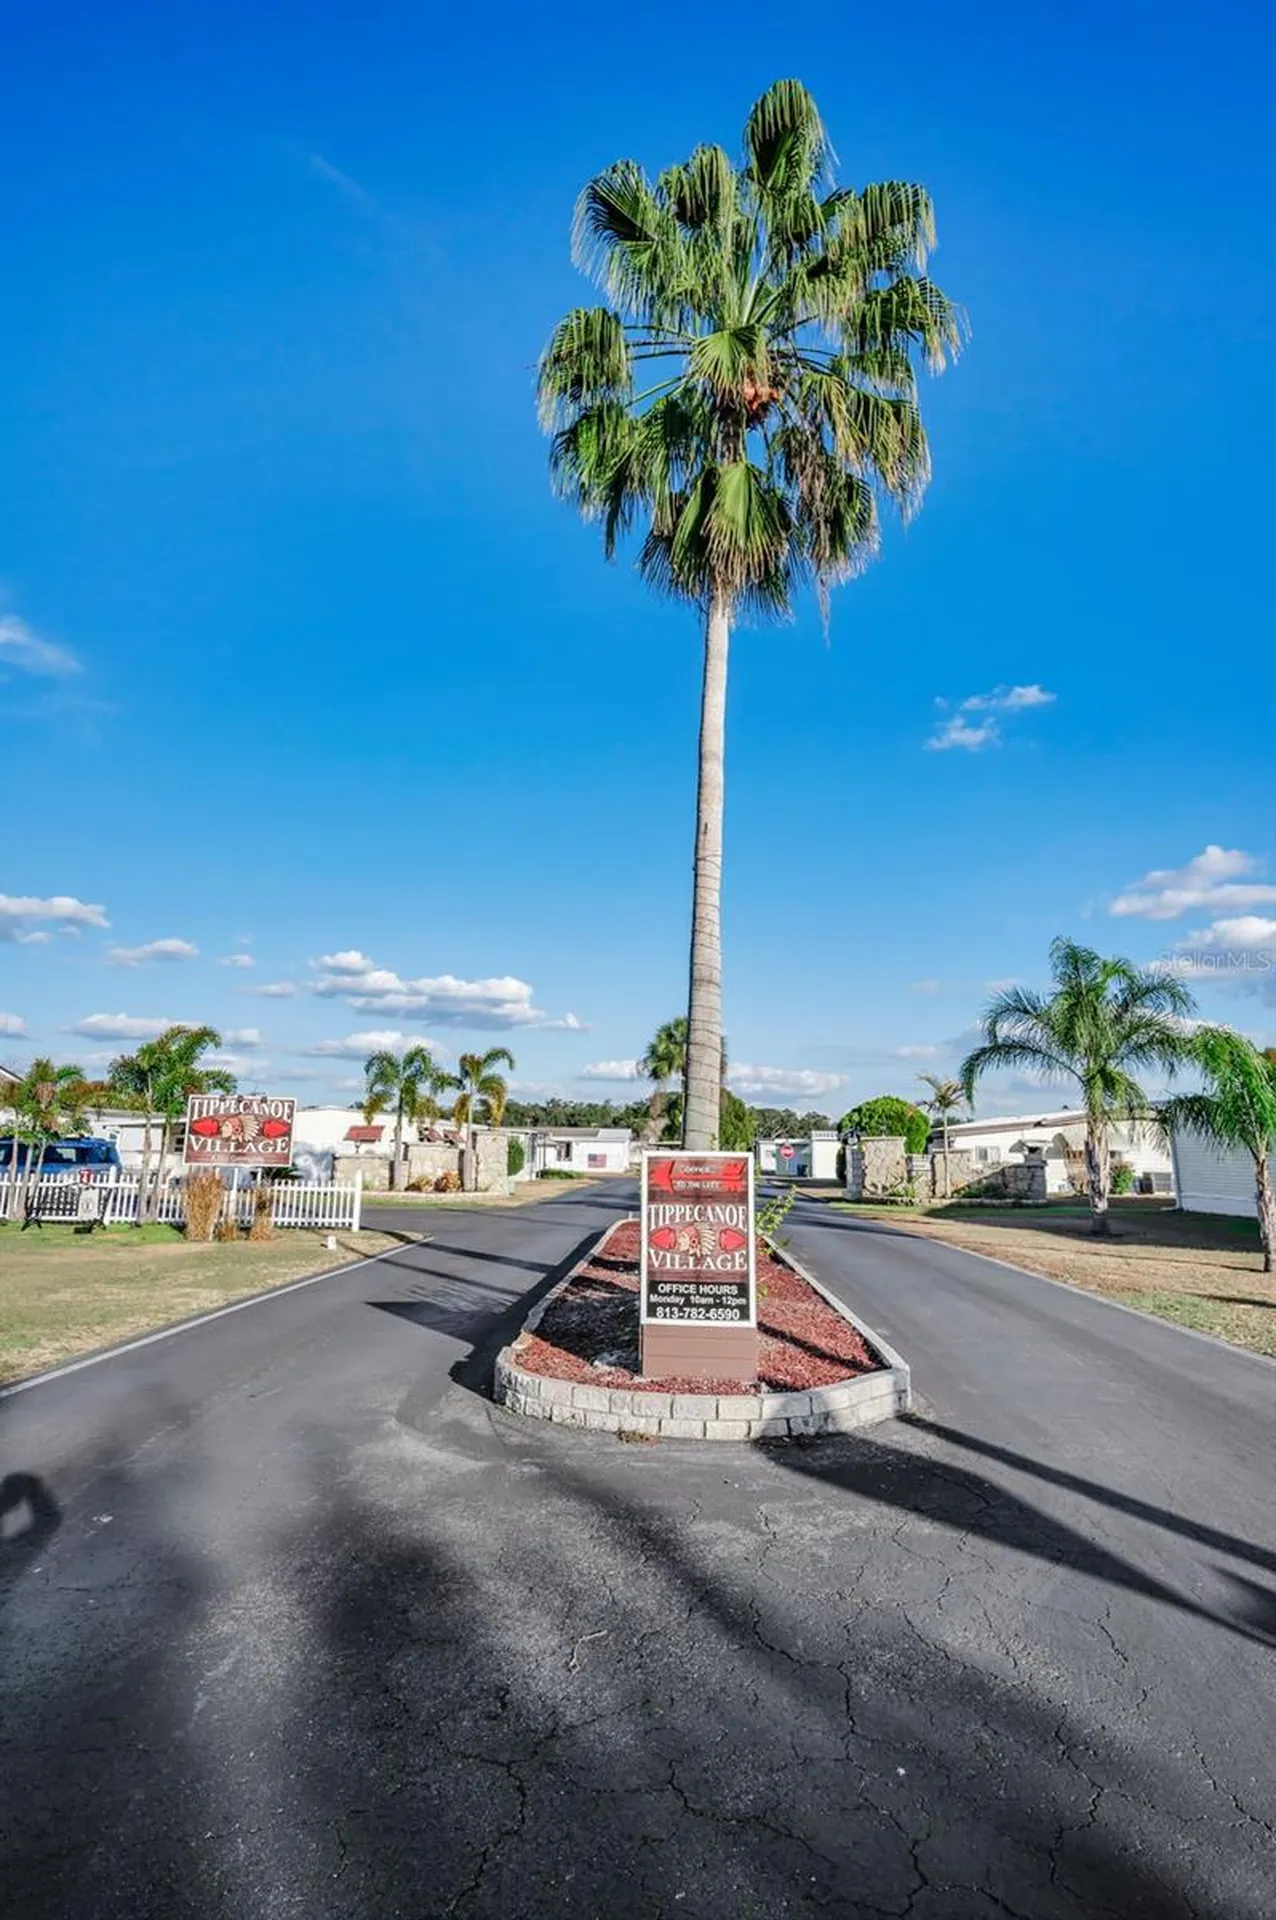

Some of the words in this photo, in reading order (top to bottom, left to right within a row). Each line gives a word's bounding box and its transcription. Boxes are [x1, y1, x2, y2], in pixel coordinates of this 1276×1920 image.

[192, 1099, 293, 1123] TIPPECANOE
[190, 1135, 289, 1153] VILLAGE
[648, 1204, 747, 1232] TIPPECANOE
[649, 1249, 747, 1271] VILLAGE
[657, 1283, 697, 1294] OFFICE
[699, 1285, 738, 1295] HOURS
[649, 1294, 685, 1305] Monday
[690, 1296, 714, 1305] 10am
[721, 1297, 747, 1306] 12pm
[656, 1307, 740, 1320] 813-782-6590
